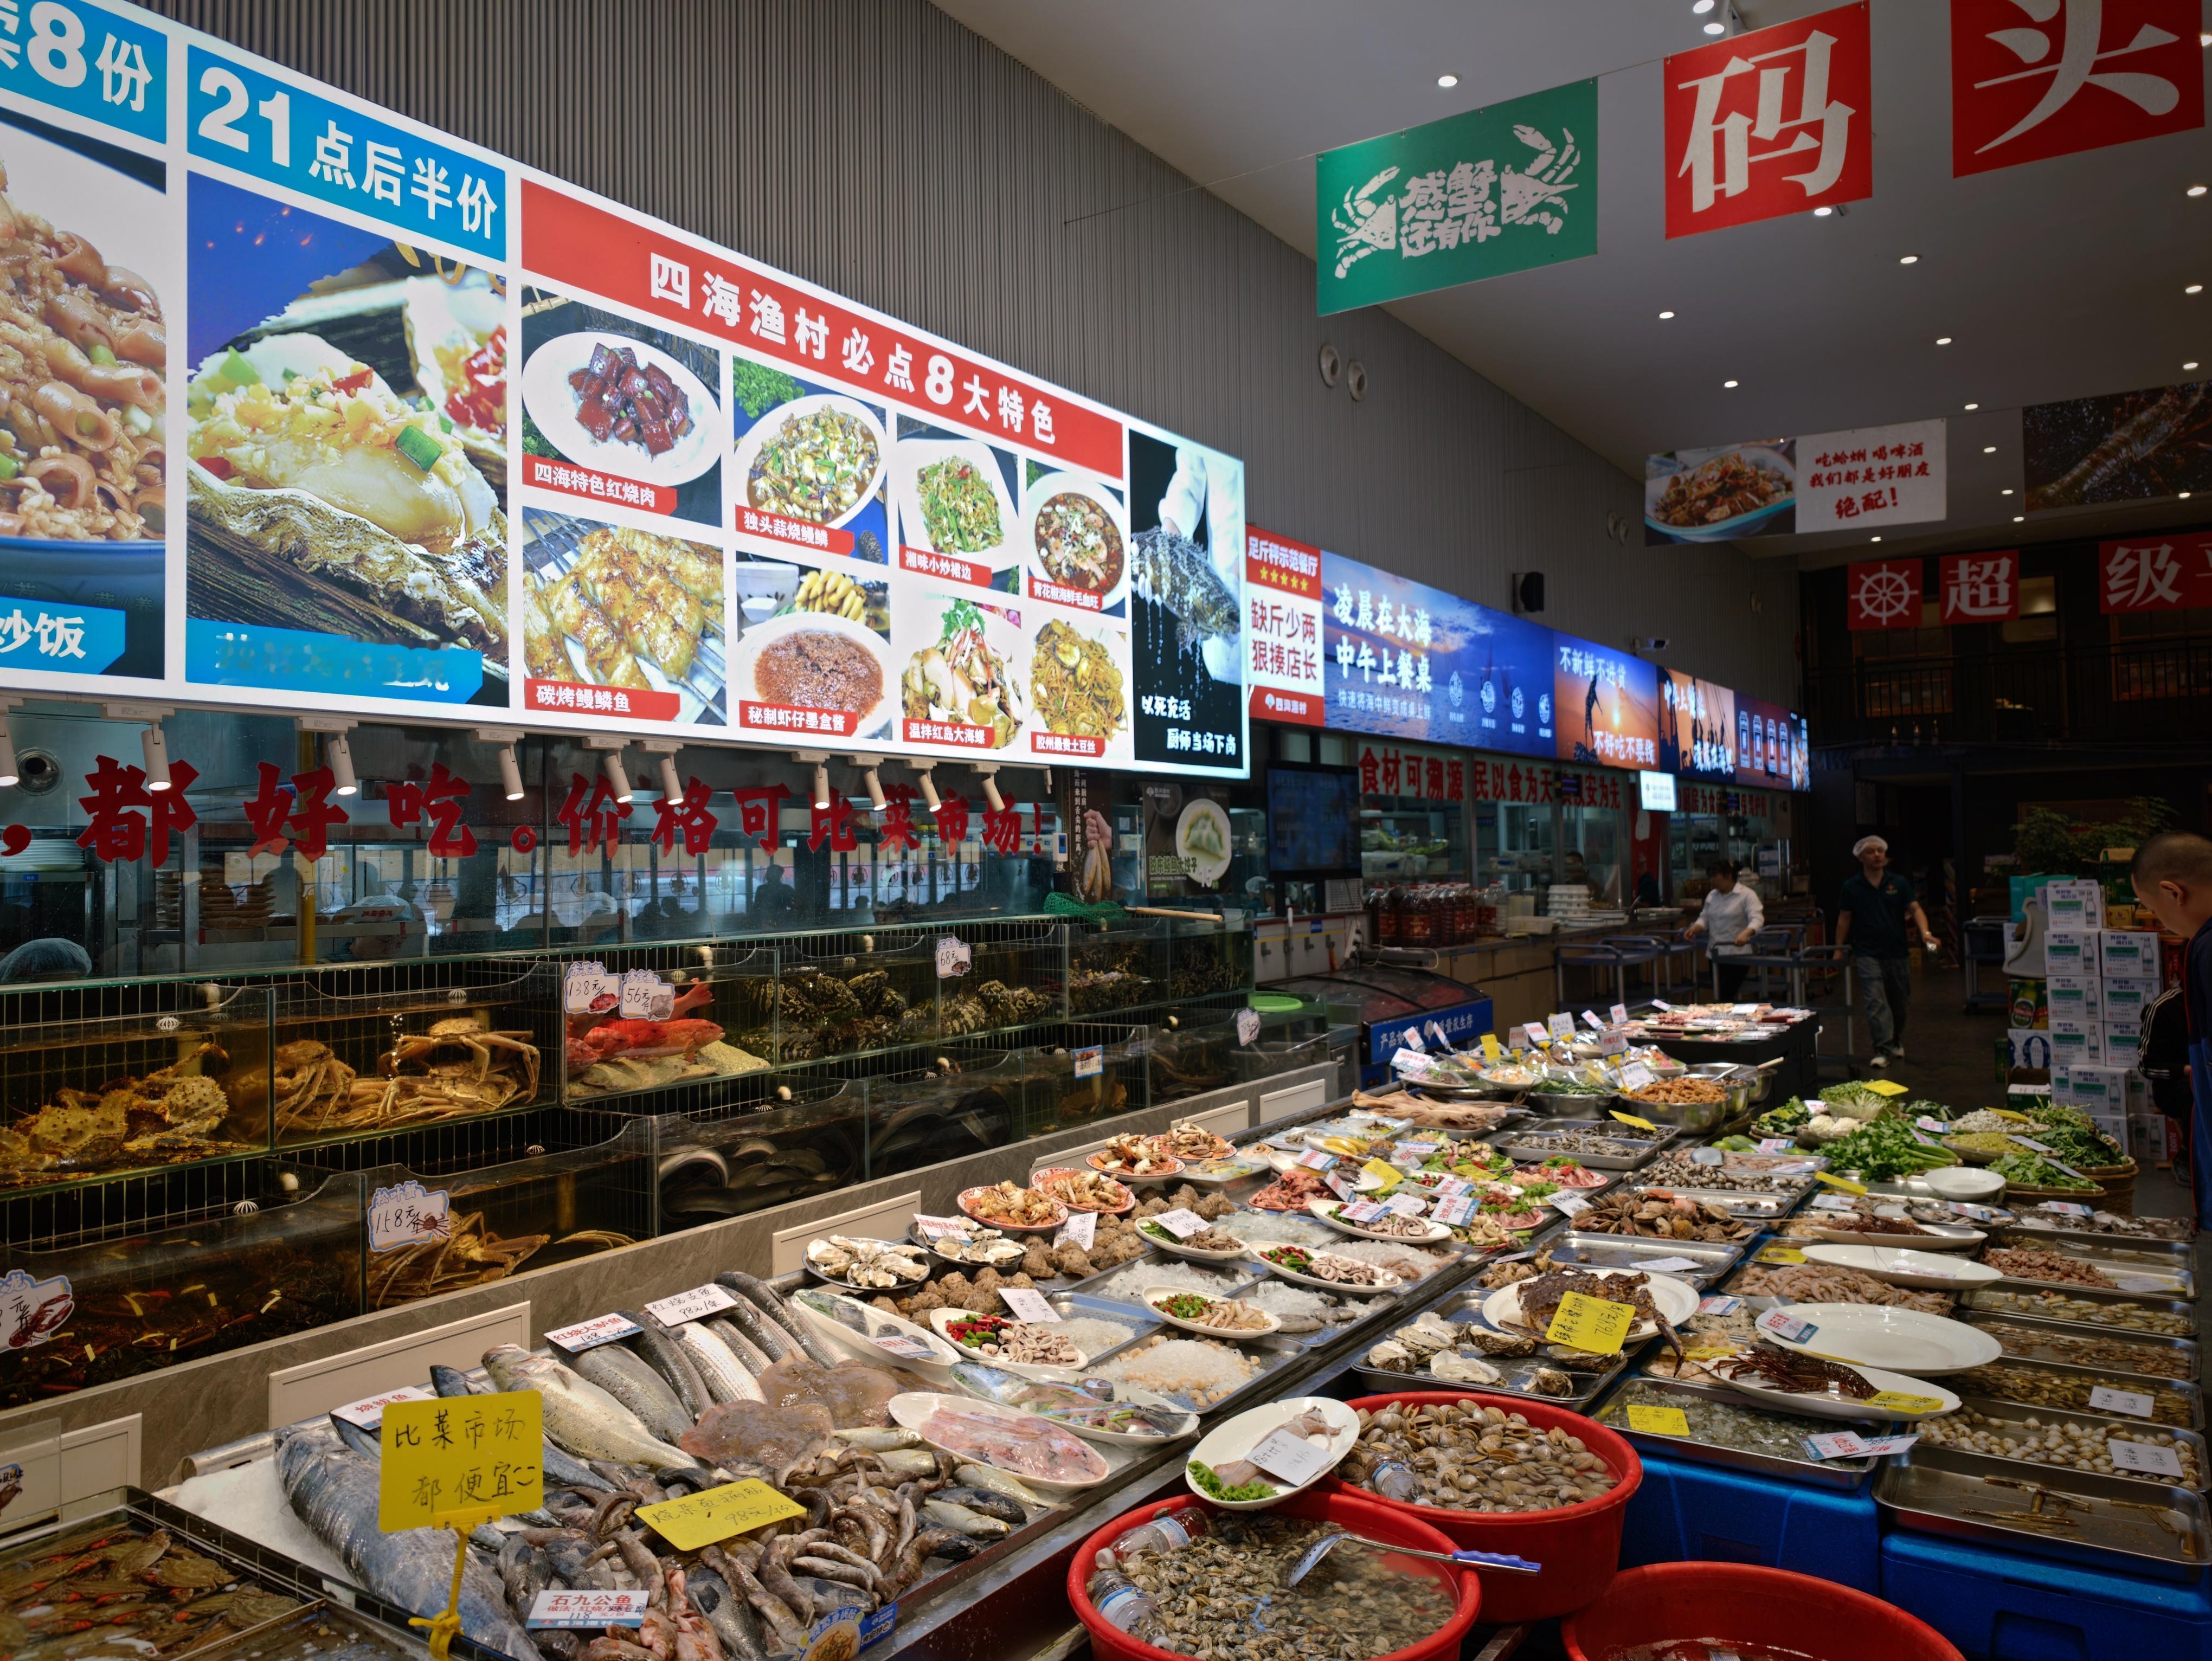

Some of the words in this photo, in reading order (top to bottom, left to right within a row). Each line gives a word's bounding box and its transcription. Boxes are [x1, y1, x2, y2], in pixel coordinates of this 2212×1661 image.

[1974, 0, 2180, 154] 头
[1677, 29, 1856, 213] 码
[198, 67, 497, 239] 21点后半价
[1401, 211, 1501, 260] 还有你
[651, 252, 1055, 445] 四海渔村必点8大特色
[1810, 461, 1930, 487] 我们都是好朋友
[1815, 448, 1866, 467] 吃蛤蜊
[1873, 442, 1924, 461] 喝啤酒
[535, 462, 655, 507] 四海特色红烧肉
[905, 551, 972, 581] 湘味小炒裙边
[1945, 556, 2013, 619] 超
[2106, 544, 2183, 609] 级
[1251, 598, 1316, 645] 缺斤少两
[1333, 583, 1432, 647] 凌晨在大海
[1251, 639, 1317, 681] 狠揍店长
[1335, 635, 1432, 693] 中午上餐桌
[1559, 646, 1626, 690] 不新鲜不进货
[909, 723, 986, 745] 温拌红岛大海螺
[1167, 728, 1237, 755] 厨师当场下岗
[1593, 730, 1656, 767] 不好吃不要钱
[1359, 746, 1464, 801] 食材可溯源
[1474, 761, 1553, 803] 民以食为天
[553, 1317, 621, 1341] 红烧大鲈鱼
[395, 1409, 526, 1451] 比菜市场
[411, 1464, 515, 1513] 都便宜
[553, 1595, 632, 1606] 石九公鱼
